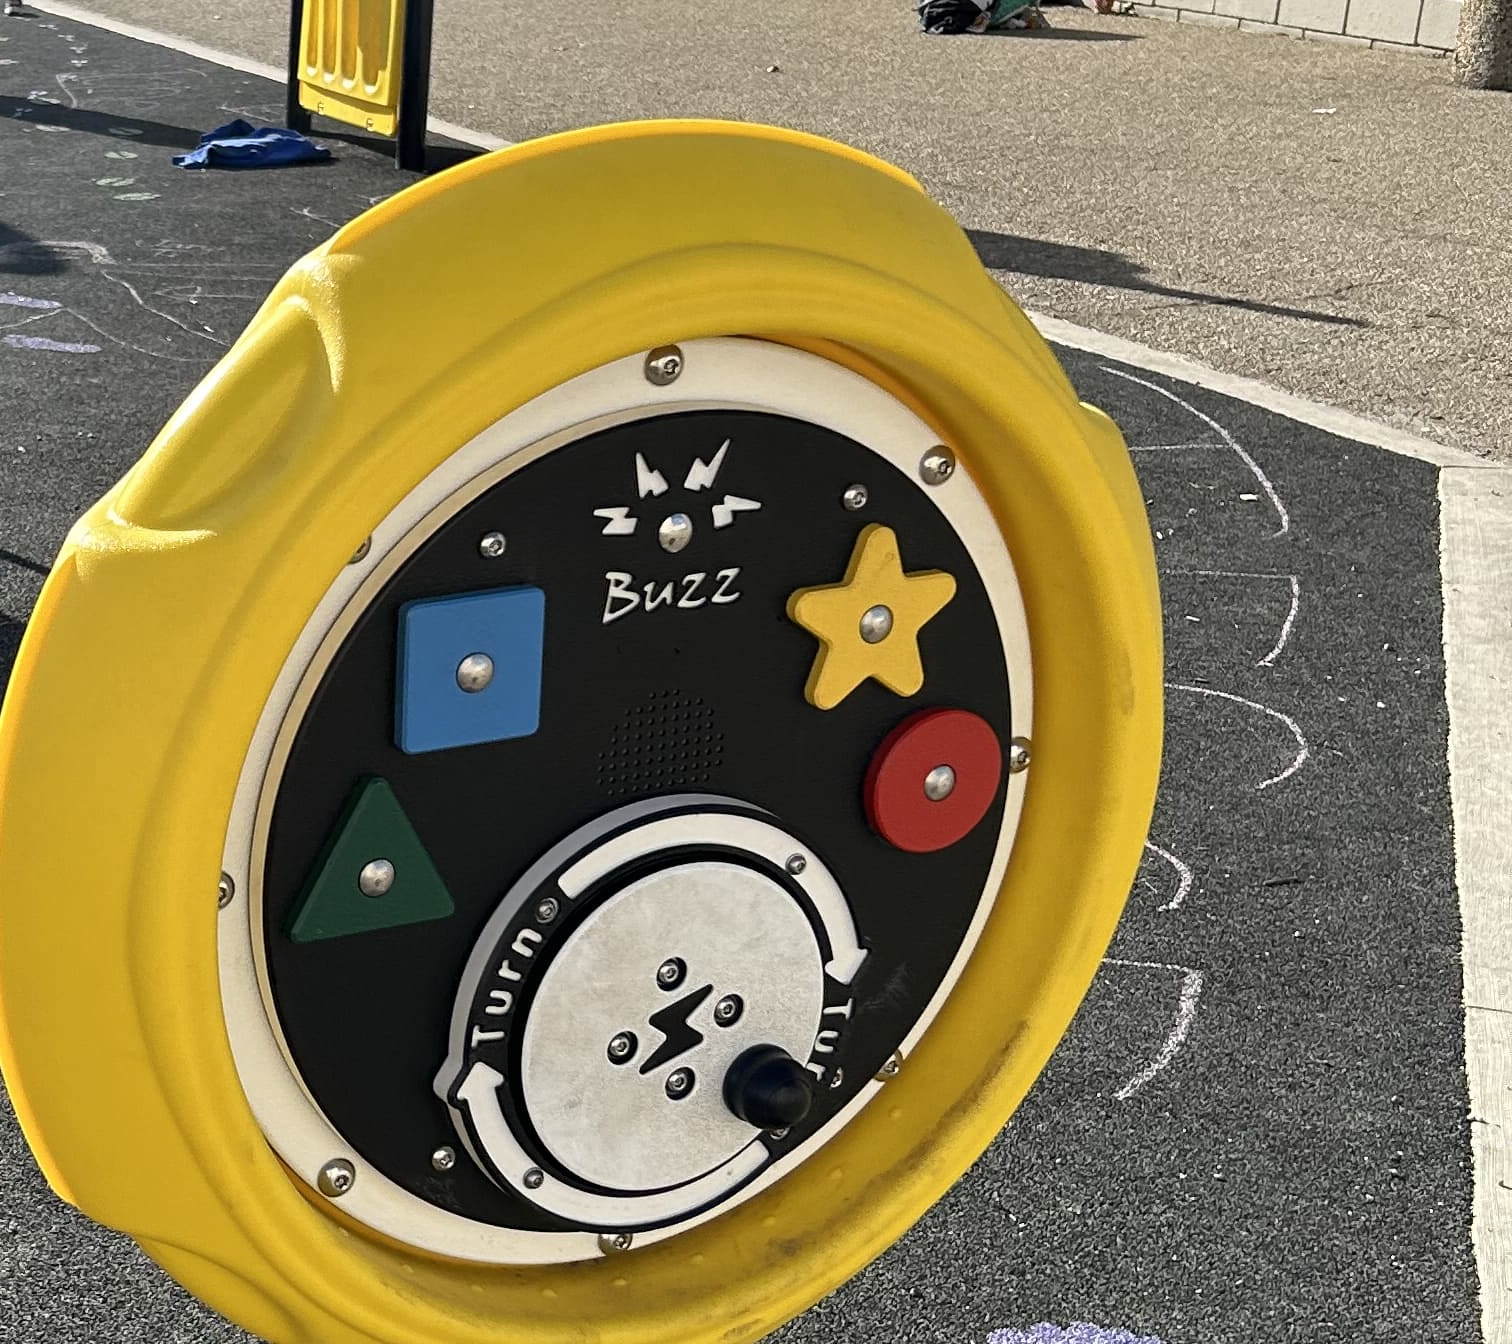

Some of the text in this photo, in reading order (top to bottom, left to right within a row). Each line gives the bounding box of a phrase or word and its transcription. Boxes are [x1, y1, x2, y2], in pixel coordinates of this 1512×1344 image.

[602, 567, 741, 624] Buzz
[471, 928, 543, 1048] Turn
[806, 997, 854, 1082] Tur
